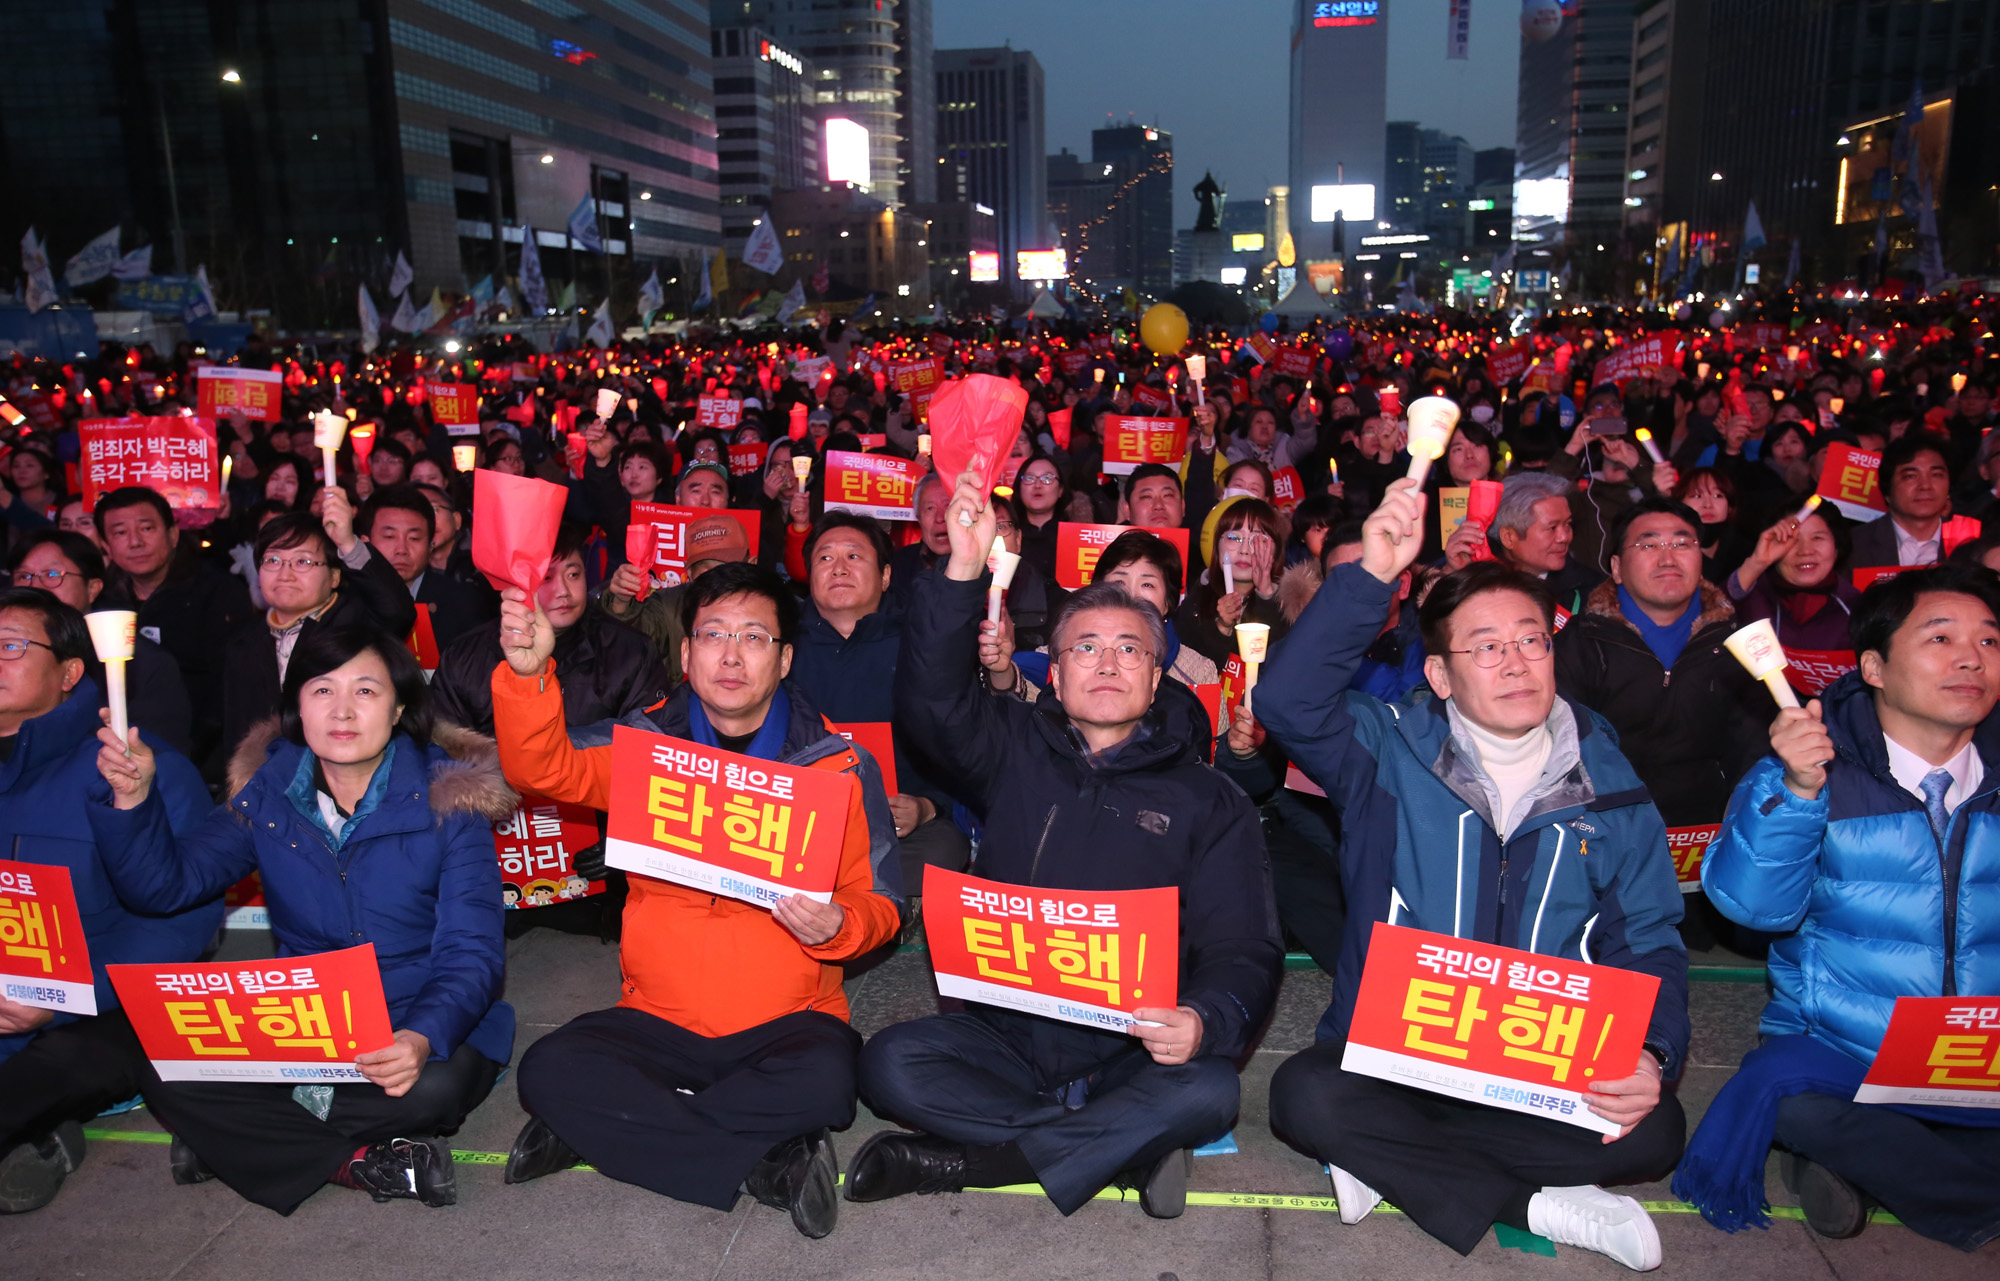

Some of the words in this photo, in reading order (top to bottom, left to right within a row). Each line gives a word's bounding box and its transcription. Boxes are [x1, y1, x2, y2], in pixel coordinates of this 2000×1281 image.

[1313, 1, 1379, 17] 조선일보
[434, 397, 467, 423] 핵!
[700, 398, 740, 412] 박근혜
[1119, 420, 1148, 431] 국민의
[1150, 421, 1175, 431] 힘으로
[88, 437, 143, 460] 범죄자
[147, 437, 208, 459] 박근혜
[1118, 432, 1180, 461] 탄핵!
[90, 462, 126, 484] 즉각
[129, 461, 210, 482] 구속하라
[728, 453, 759, 468] 근혜를
[842, 456, 874, 469] 국민의
[876, 458, 907, 471] 힘으로
[841, 470, 917, 505] 탄핵!
[1273, 474, 1295, 499] 핵
[1443, 497, 1468, 508] 박근
[693, 528, 727, 541] JOURNEY
[652, 745, 718, 784] 국민의
[724, 762, 794, 800] 힘으로
[648, 774, 817, 878] 탄핵!
[498, 842, 569, 877] 하라
[0, 871, 37, 896] 으로
[720, 876, 788, 903] 더불어민주
[960, 886, 1033, 921] 국민의
[1039, 899, 1119, 927] 힘으로
[962, 917, 1147, 1006] 탄핵!
[1416, 943, 1500, 984] 국민의
[1507, 961, 1590, 1002] 힘으로
[6, 984, 66, 1004] 더불어민주당
[155, 972, 234, 996] 국민의
[237, 967, 319, 994] 힘으로
[164, 990, 357, 1058] 탄핵!
[1402, 978, 1614, 1082] 탄핵!
[1945, 1007, 2000, 1028] 국민
[1484, 1083, 1577, 1115] 더불어민주당
